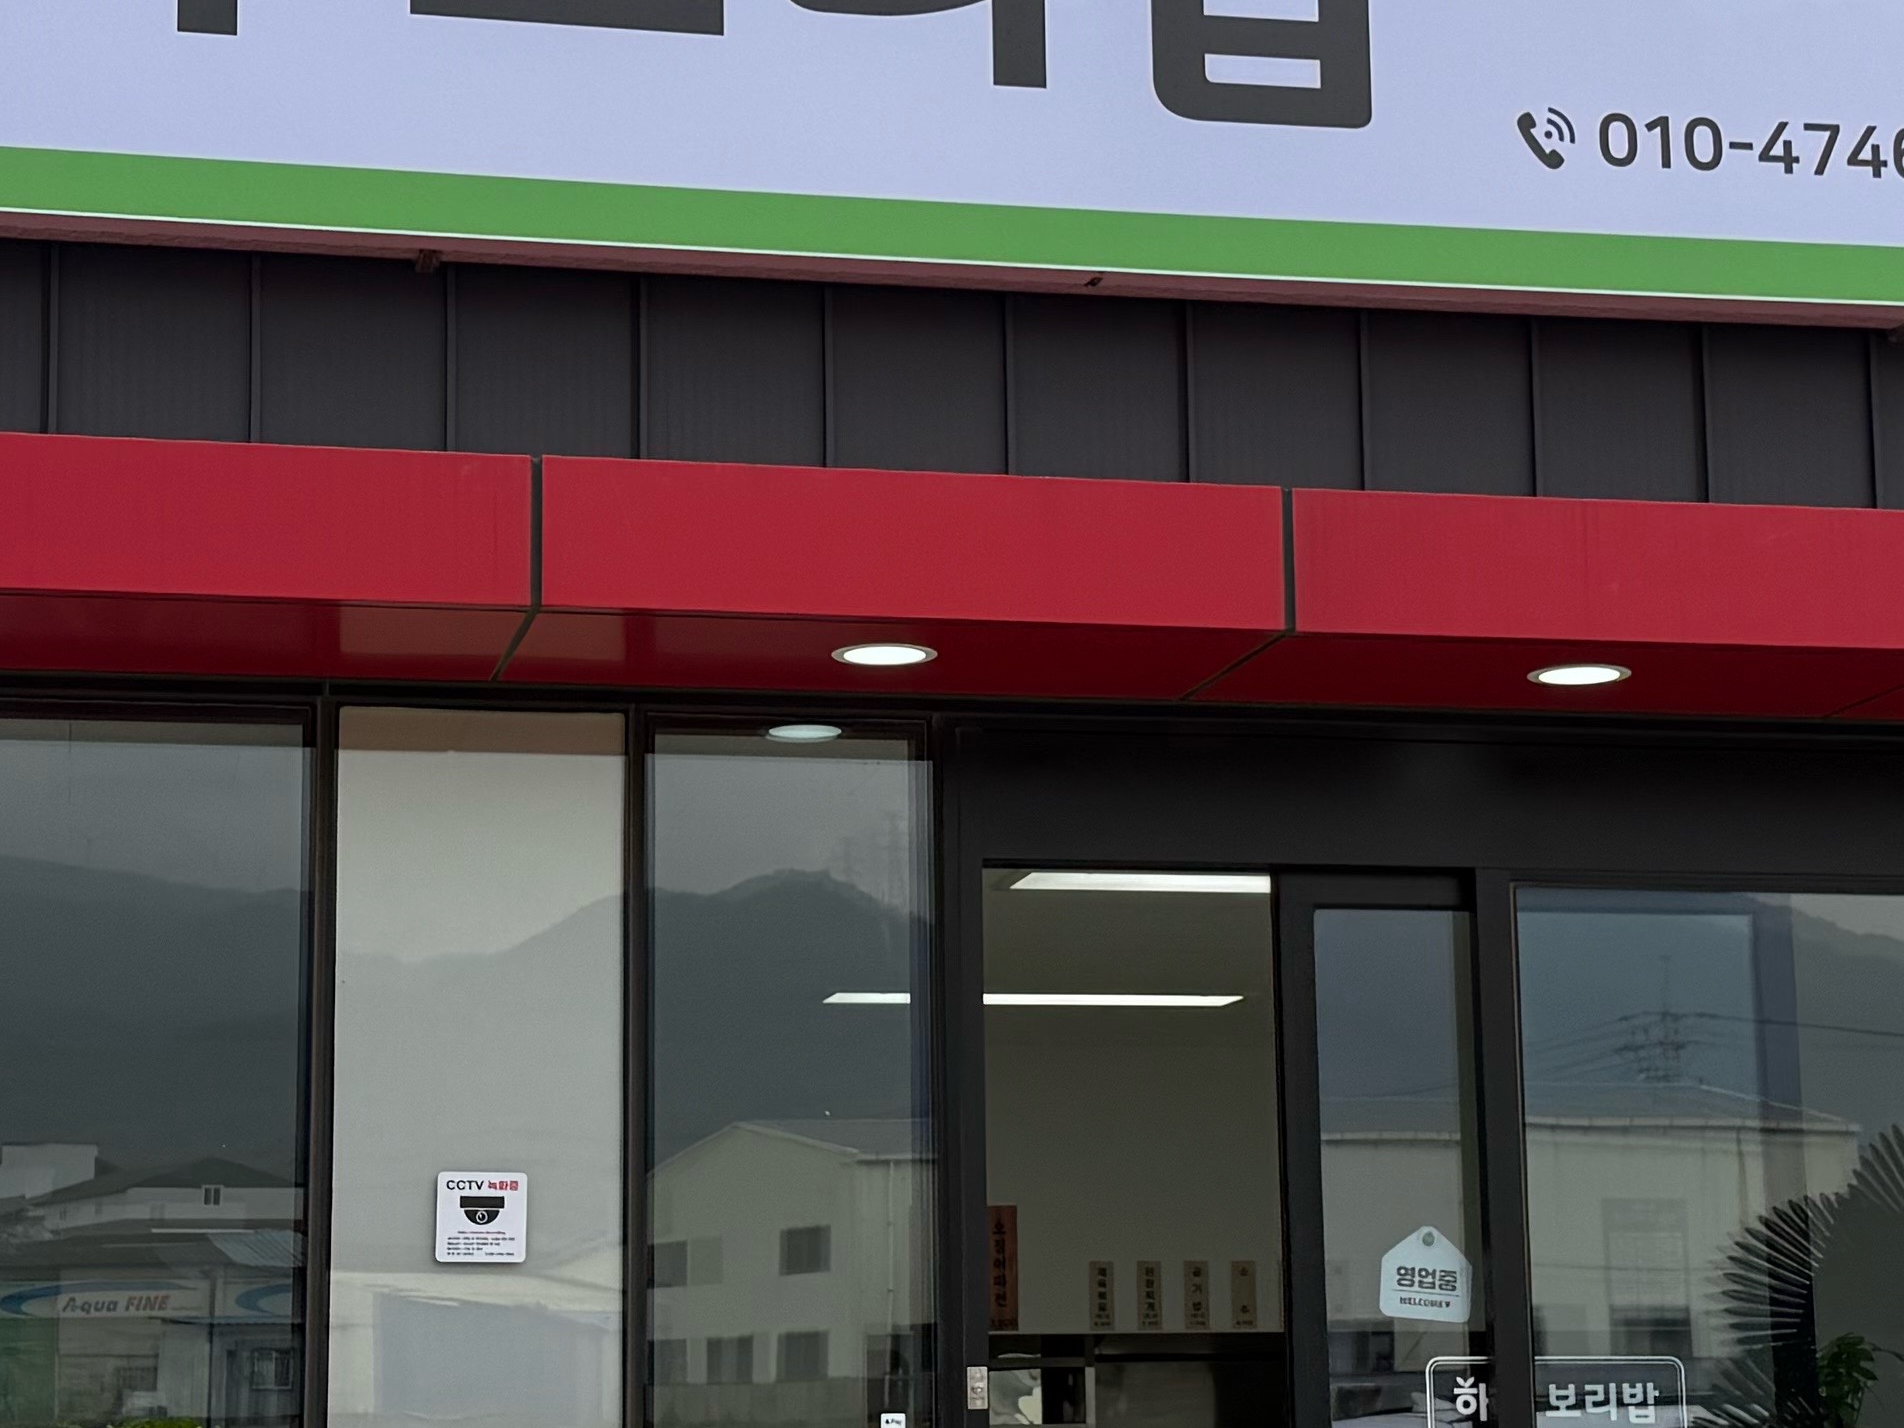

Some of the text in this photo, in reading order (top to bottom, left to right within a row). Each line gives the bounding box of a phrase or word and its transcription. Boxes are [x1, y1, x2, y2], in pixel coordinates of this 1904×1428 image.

[446, 1179, 484, 1191] CCTV
[1396, 1266, 1457, 1292] 영업중
[124, 1294, 171, 1312] FINE
[1545, 1382, 1660, 1425] 보리밥
